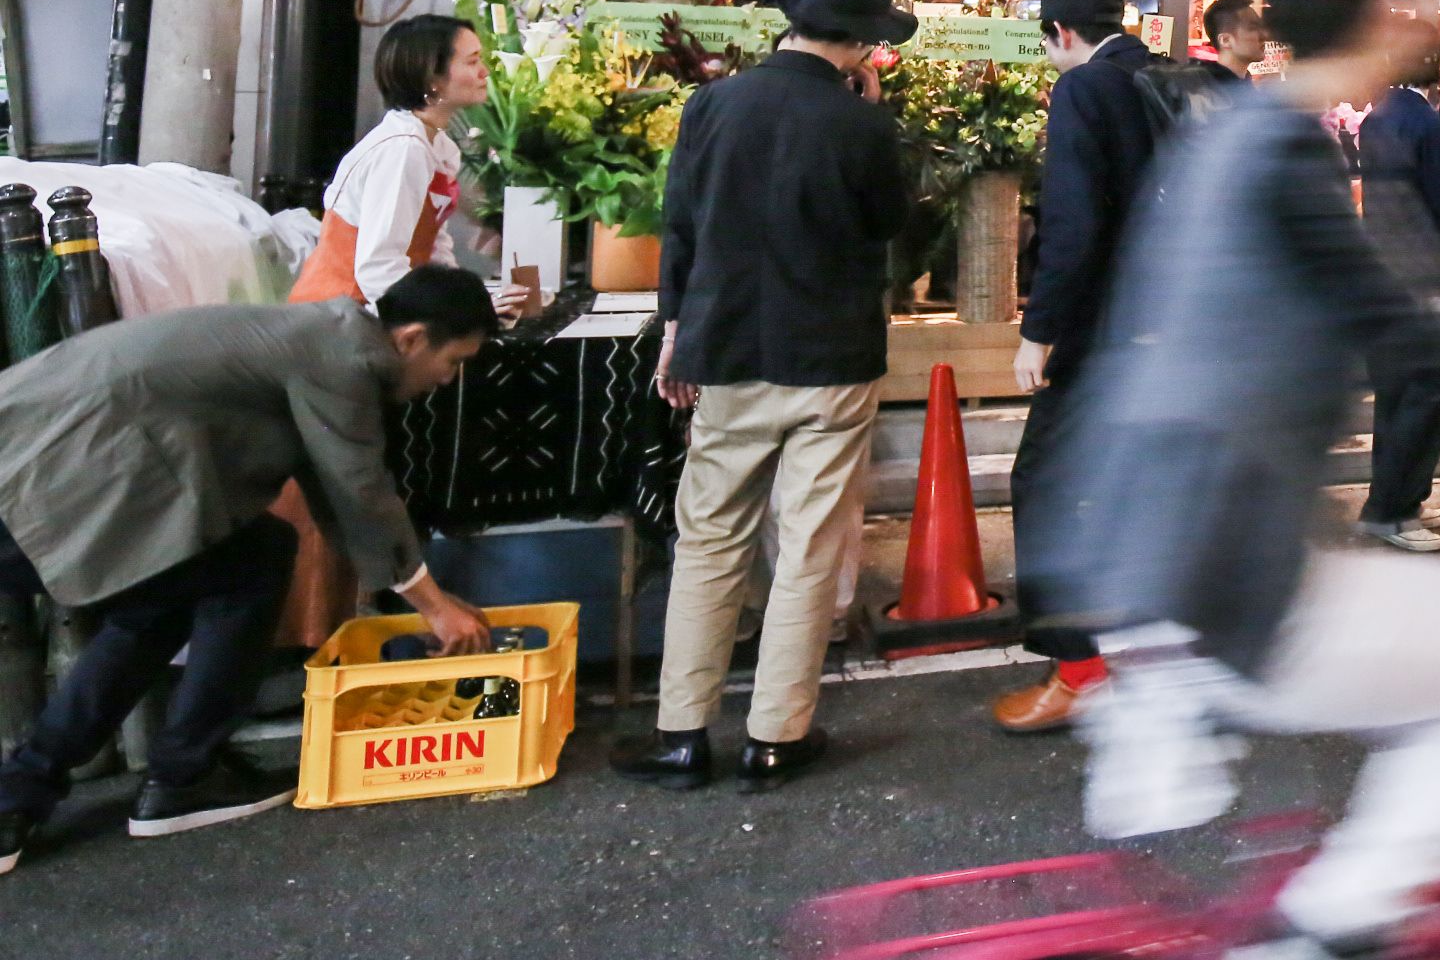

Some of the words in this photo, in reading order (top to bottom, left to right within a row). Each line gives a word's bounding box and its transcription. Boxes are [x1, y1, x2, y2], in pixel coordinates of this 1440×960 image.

[364, 730, 485, 769] KIRIN
[400, 769, 446, 782] キリンビール
